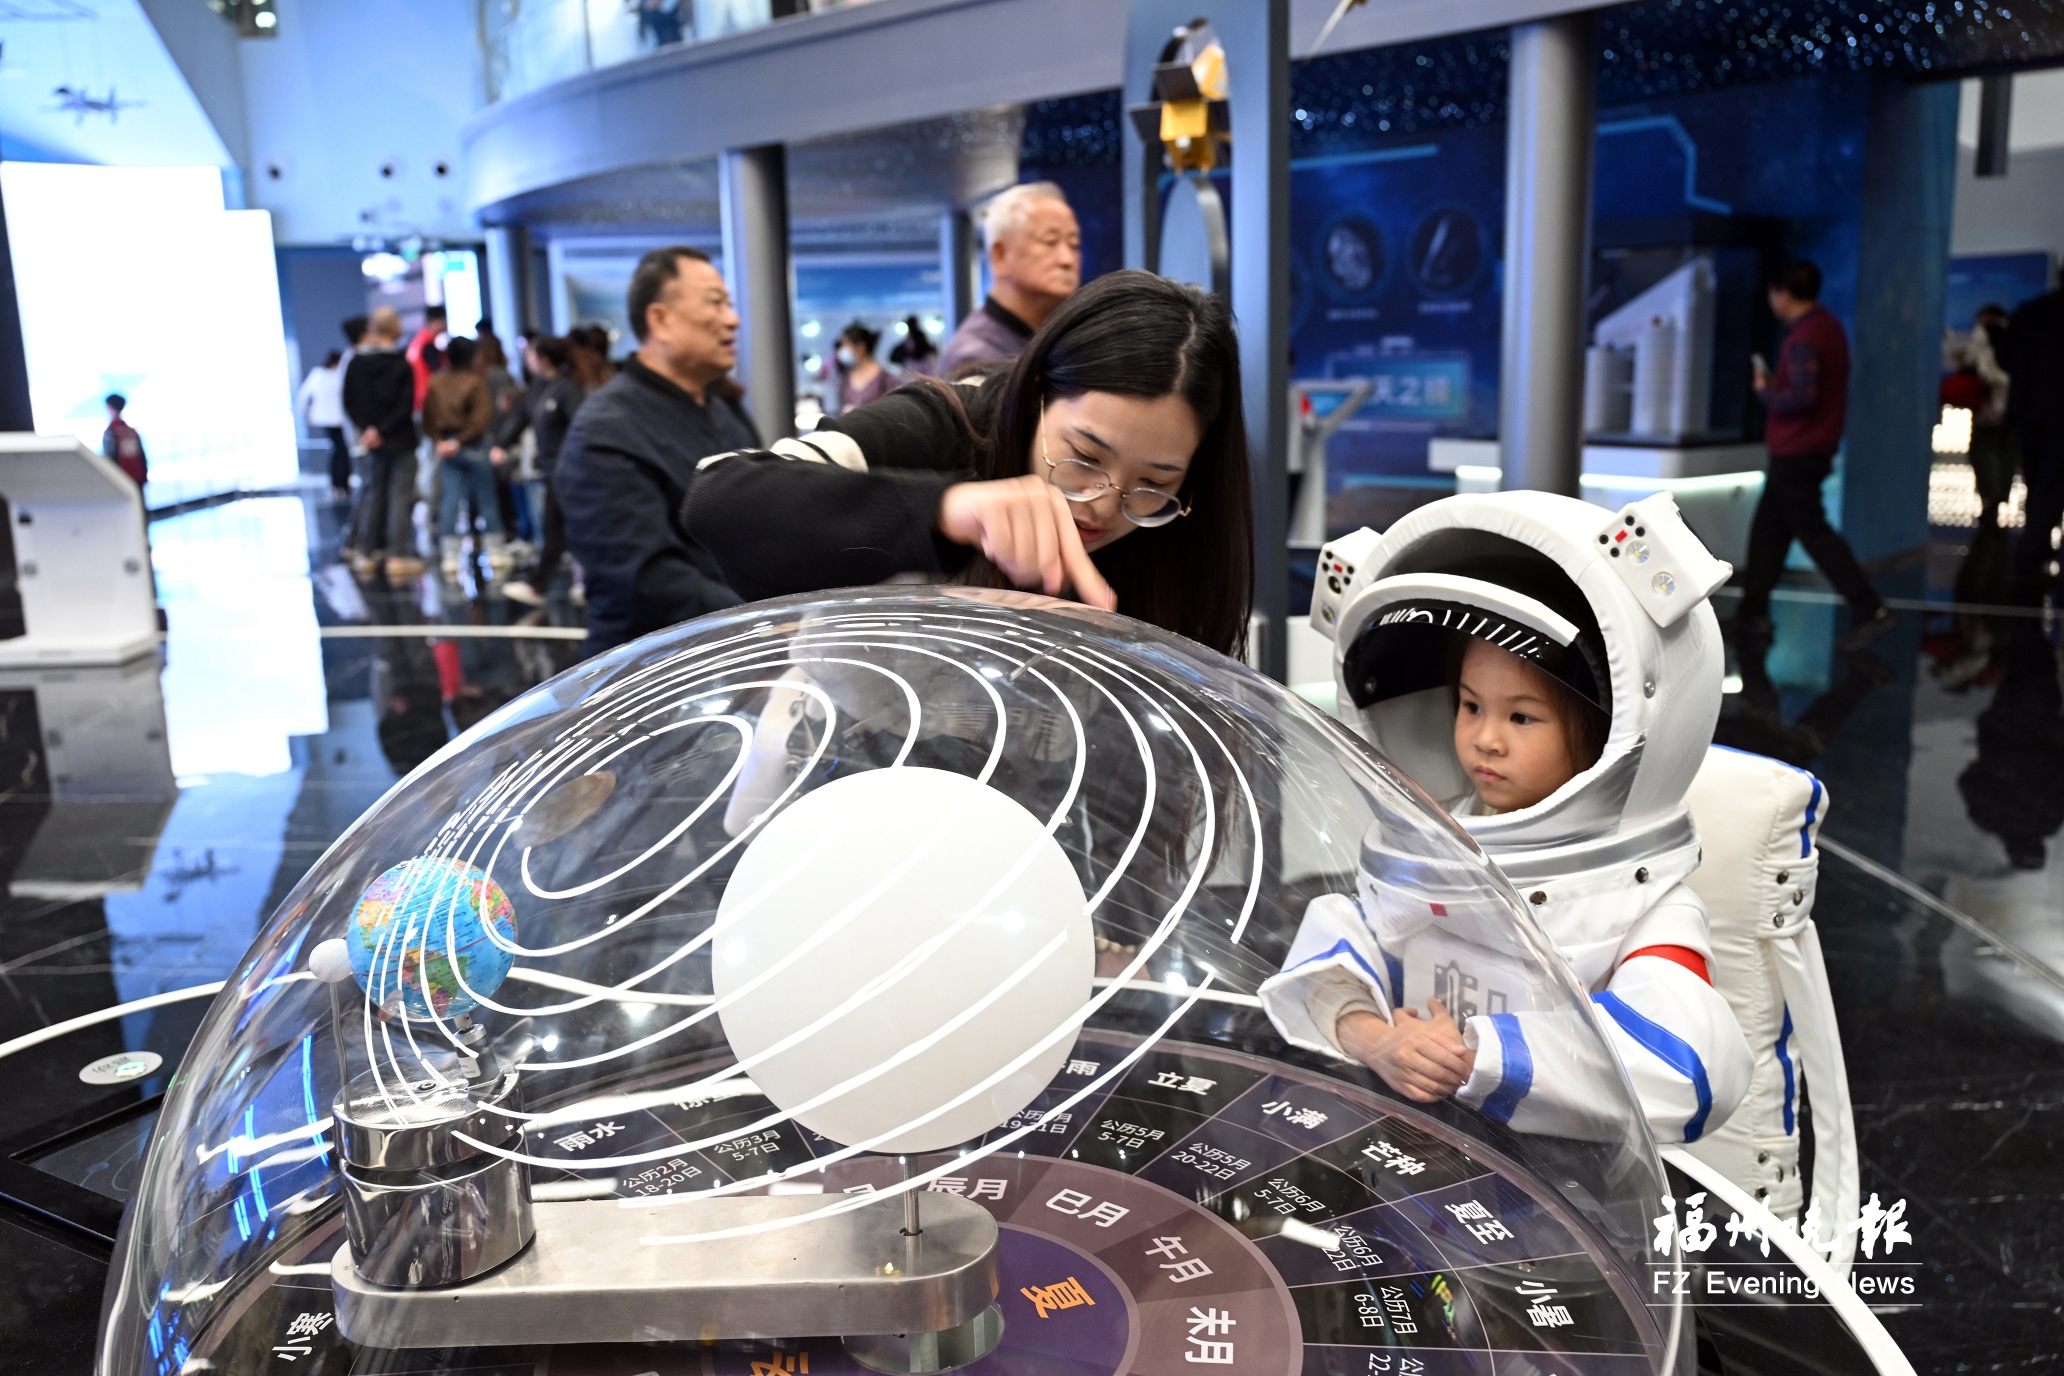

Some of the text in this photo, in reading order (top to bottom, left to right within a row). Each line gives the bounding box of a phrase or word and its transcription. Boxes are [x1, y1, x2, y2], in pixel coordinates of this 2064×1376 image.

[1060, 1059, 1100, 1077] 雨
[1147, 1071, 1218, 1096] 立夏
[1100, 1119, 1166, 1141] 公历5月
[1260, 1100, 1329, 1130] 小满
[552, 1120, 626, 1152] 雨水
[713, 1129, 781, 1154] 公历3月
[732, 1141, 780, 1162] 5-7日
[1097, 1131, 1145, 1149] 5-7日
[1170, 1150, 1237, 1181] 20-22日
[1188, 1142, 1252, 1171] 公历5月
[1361, 1140, 1427, 1176] 芒种
[622, 1157, 688, 1189] 公历2月
[634, 1165, 703, 1197] 18-20日
[926, 1176, 1009, 1200] 辰月
[1253, 1188, 1297, 1215] 5-7日
[1267, 1178, 1326, 1213] 公历6月
[1443, 1199, 1515, 1245] 夏至
[1144, 1236, 1214, 1283] 午月
[1333, 1225, 1384, 1267] 公历6月
[1019, 1276, 1097, 1319] 夏
[1353, 1293, 1385, 1328] 6-8日
[1380, 1285, 1418, 1334] 公历7月
[1514, 1280, 1575, 1328] 小暑
[271, 1312, 334, 1362] 小寒
[1184, 1306, 1237, 1365] 未月
